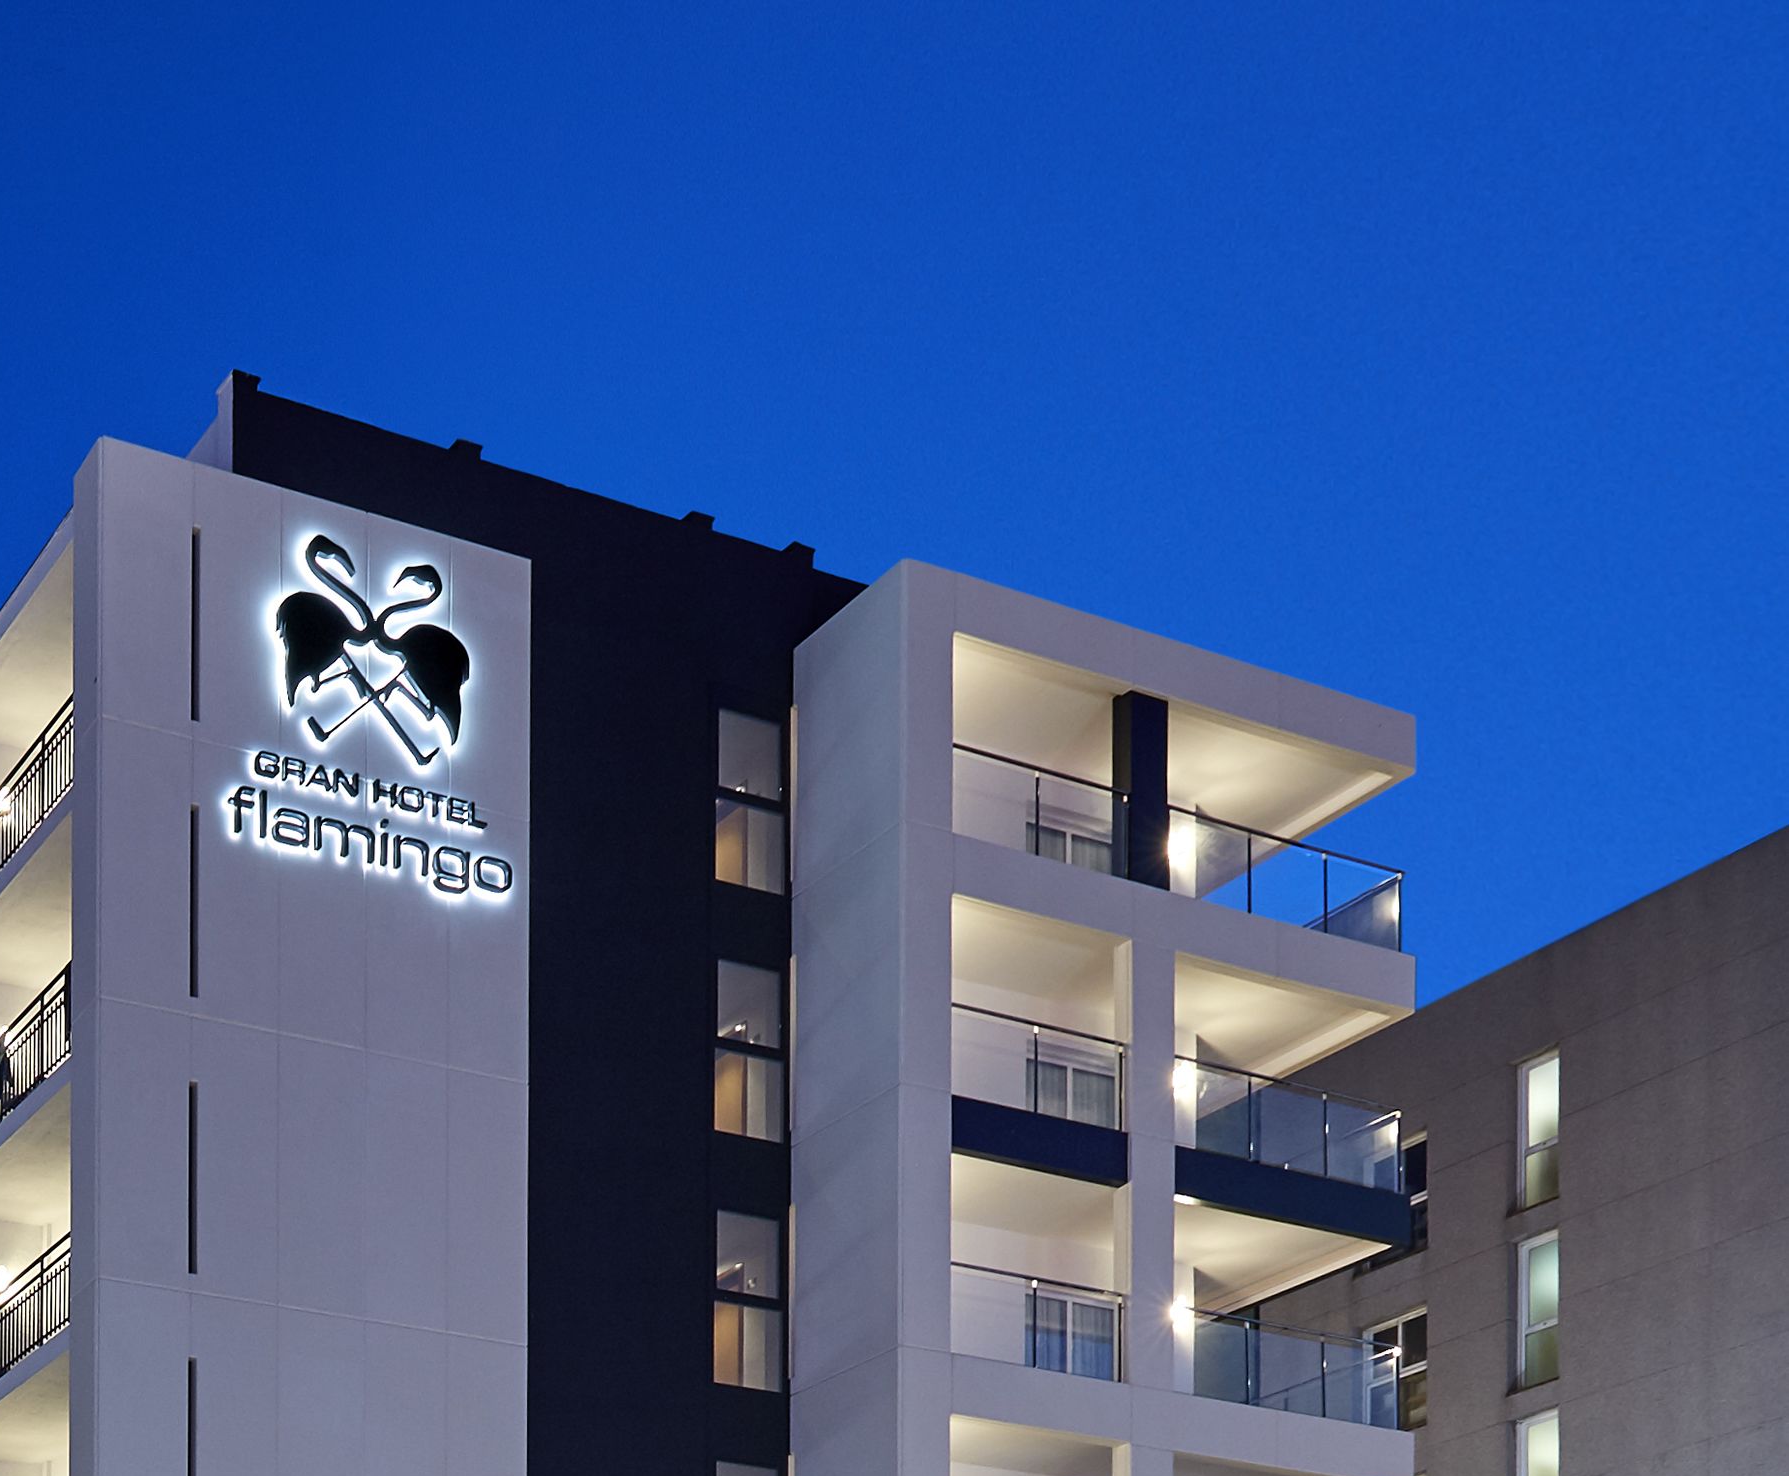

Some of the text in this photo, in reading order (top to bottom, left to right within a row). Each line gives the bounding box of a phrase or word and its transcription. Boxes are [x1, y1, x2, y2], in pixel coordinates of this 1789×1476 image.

[254, 751, 488, 829] GRAN HOTEL
[228, 785, 513, 894] flamingo
